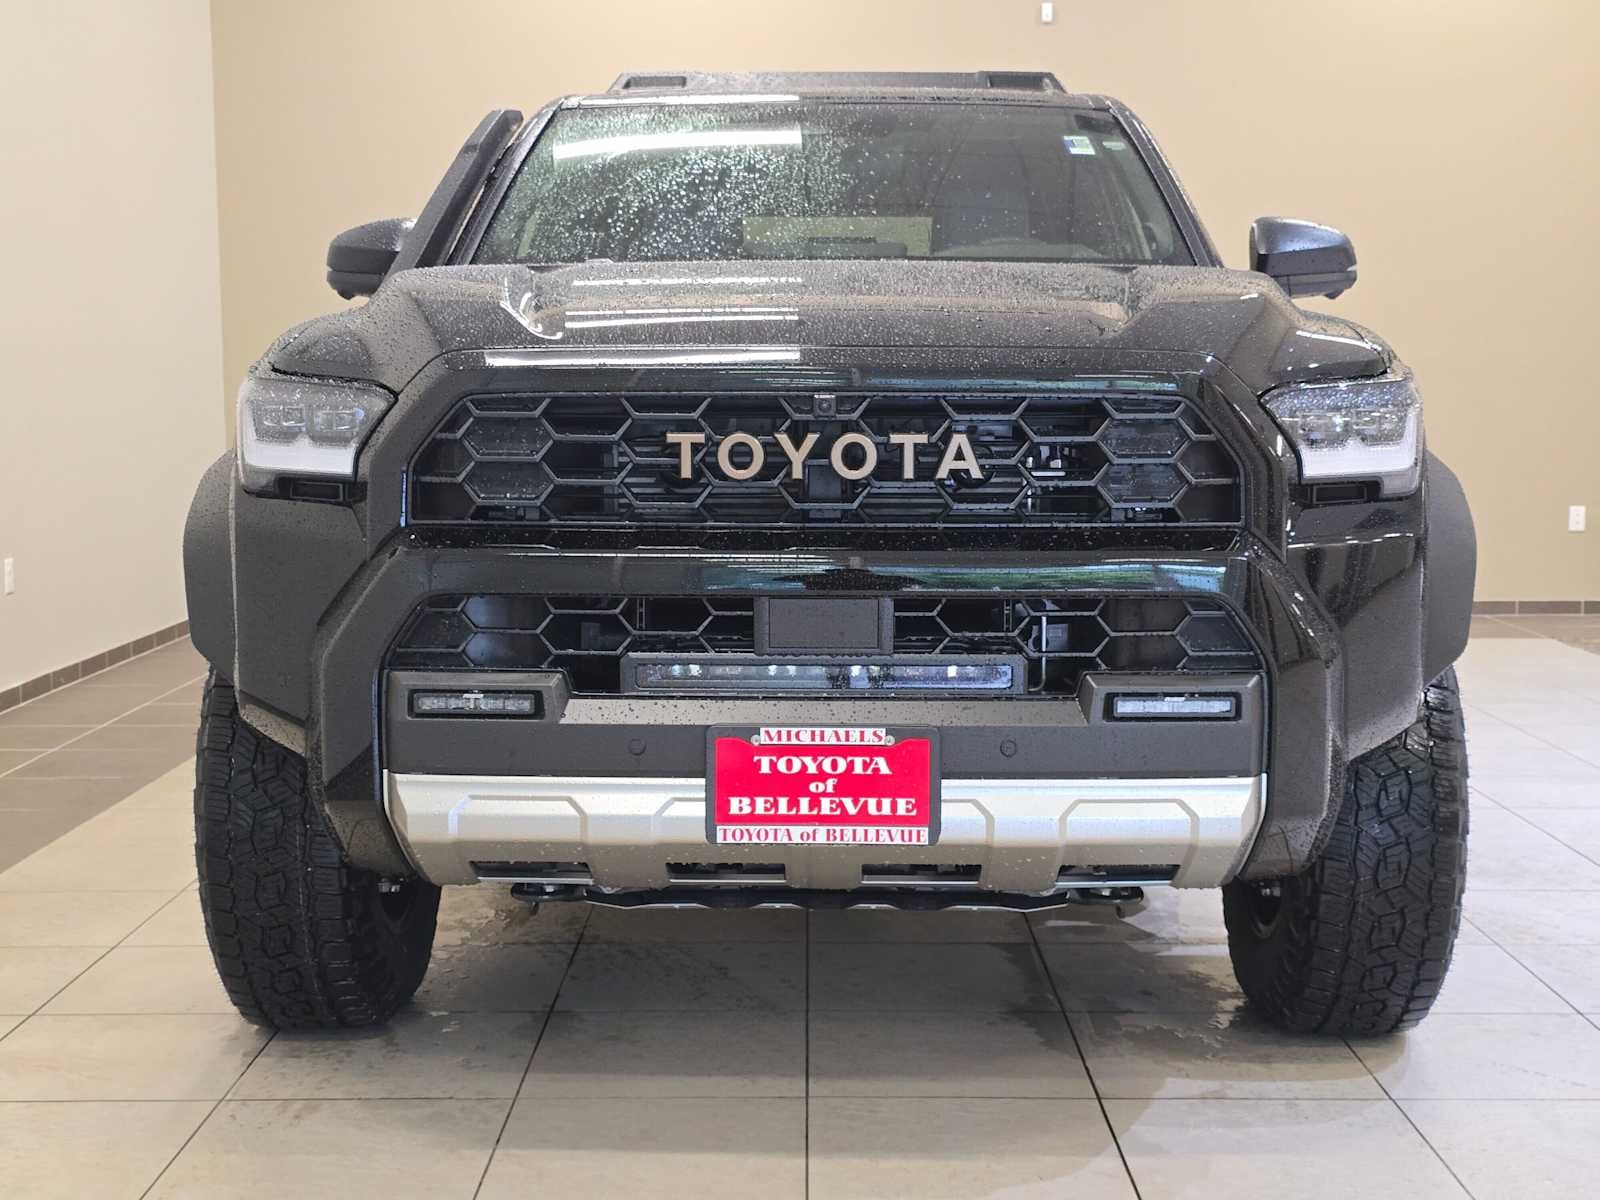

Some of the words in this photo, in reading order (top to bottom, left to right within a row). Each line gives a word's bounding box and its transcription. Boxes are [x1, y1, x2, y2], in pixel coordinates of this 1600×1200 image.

[665, 432, 985, 480] TOYOTA
[762, 729, 884, 743] MICHAELS
[753, 756, 892, 775] TOYOTA
[809, 778, 837, 793] of
[728, 797, 917, 816] BELLEVUE
[719, 827, 793, 842] TOYOTA
[799, 827, 819, 842] of
[825, 828, 927, 843] BELLEVUE
